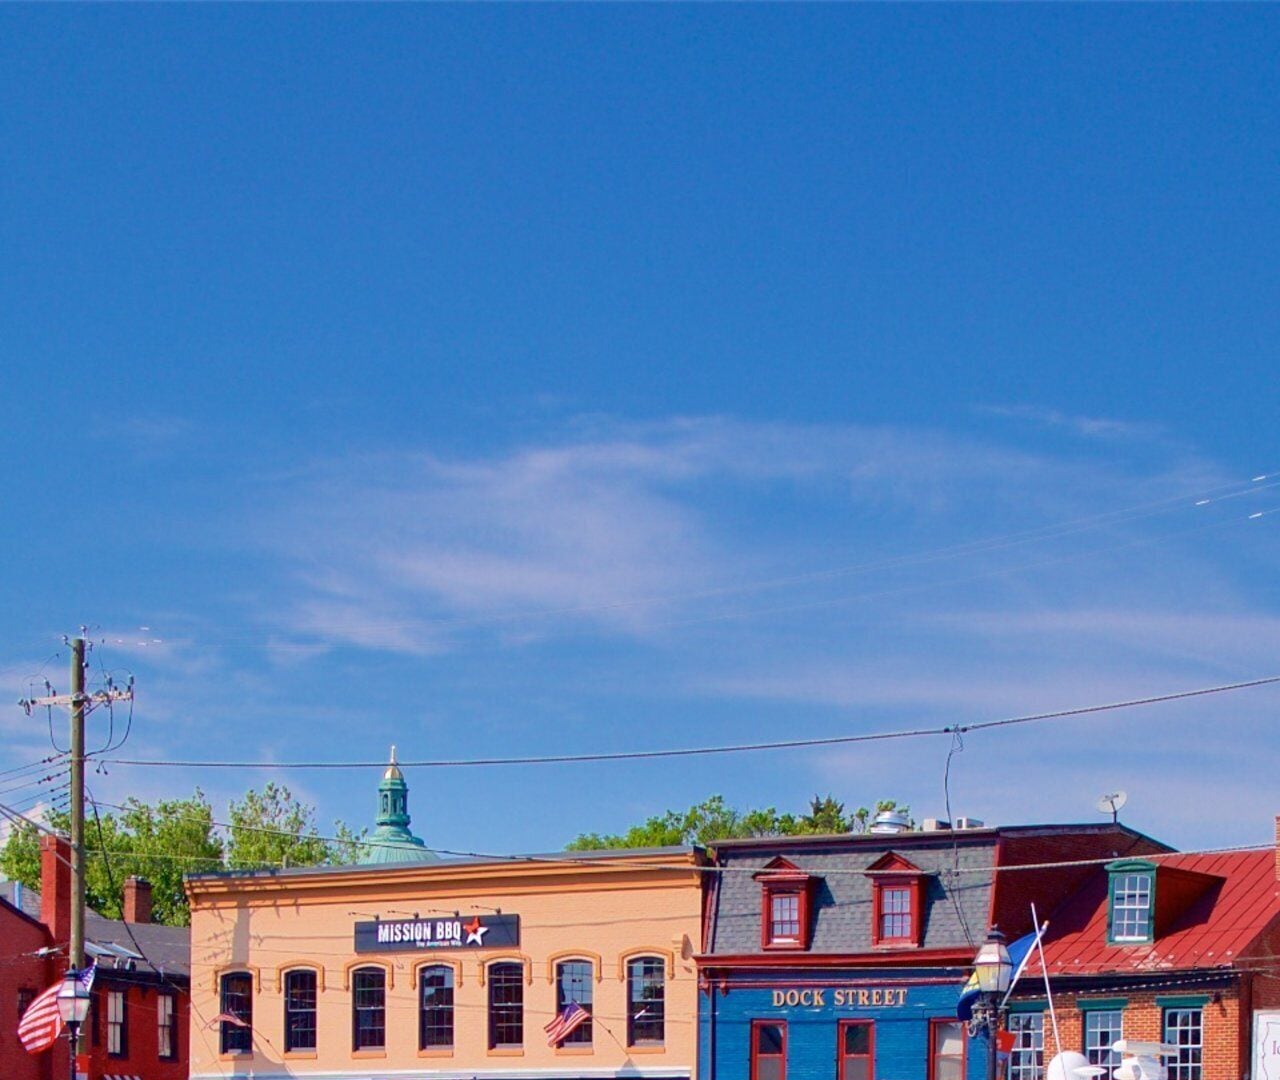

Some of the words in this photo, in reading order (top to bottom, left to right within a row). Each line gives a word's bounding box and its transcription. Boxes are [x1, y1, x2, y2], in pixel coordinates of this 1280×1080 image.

[378, 922, 431, 942] MISSION
[436, 921, 462, 940] BBQ
[772, 989, 826, 1007] DOCK
[833, 989, 908, 1006] STREET
